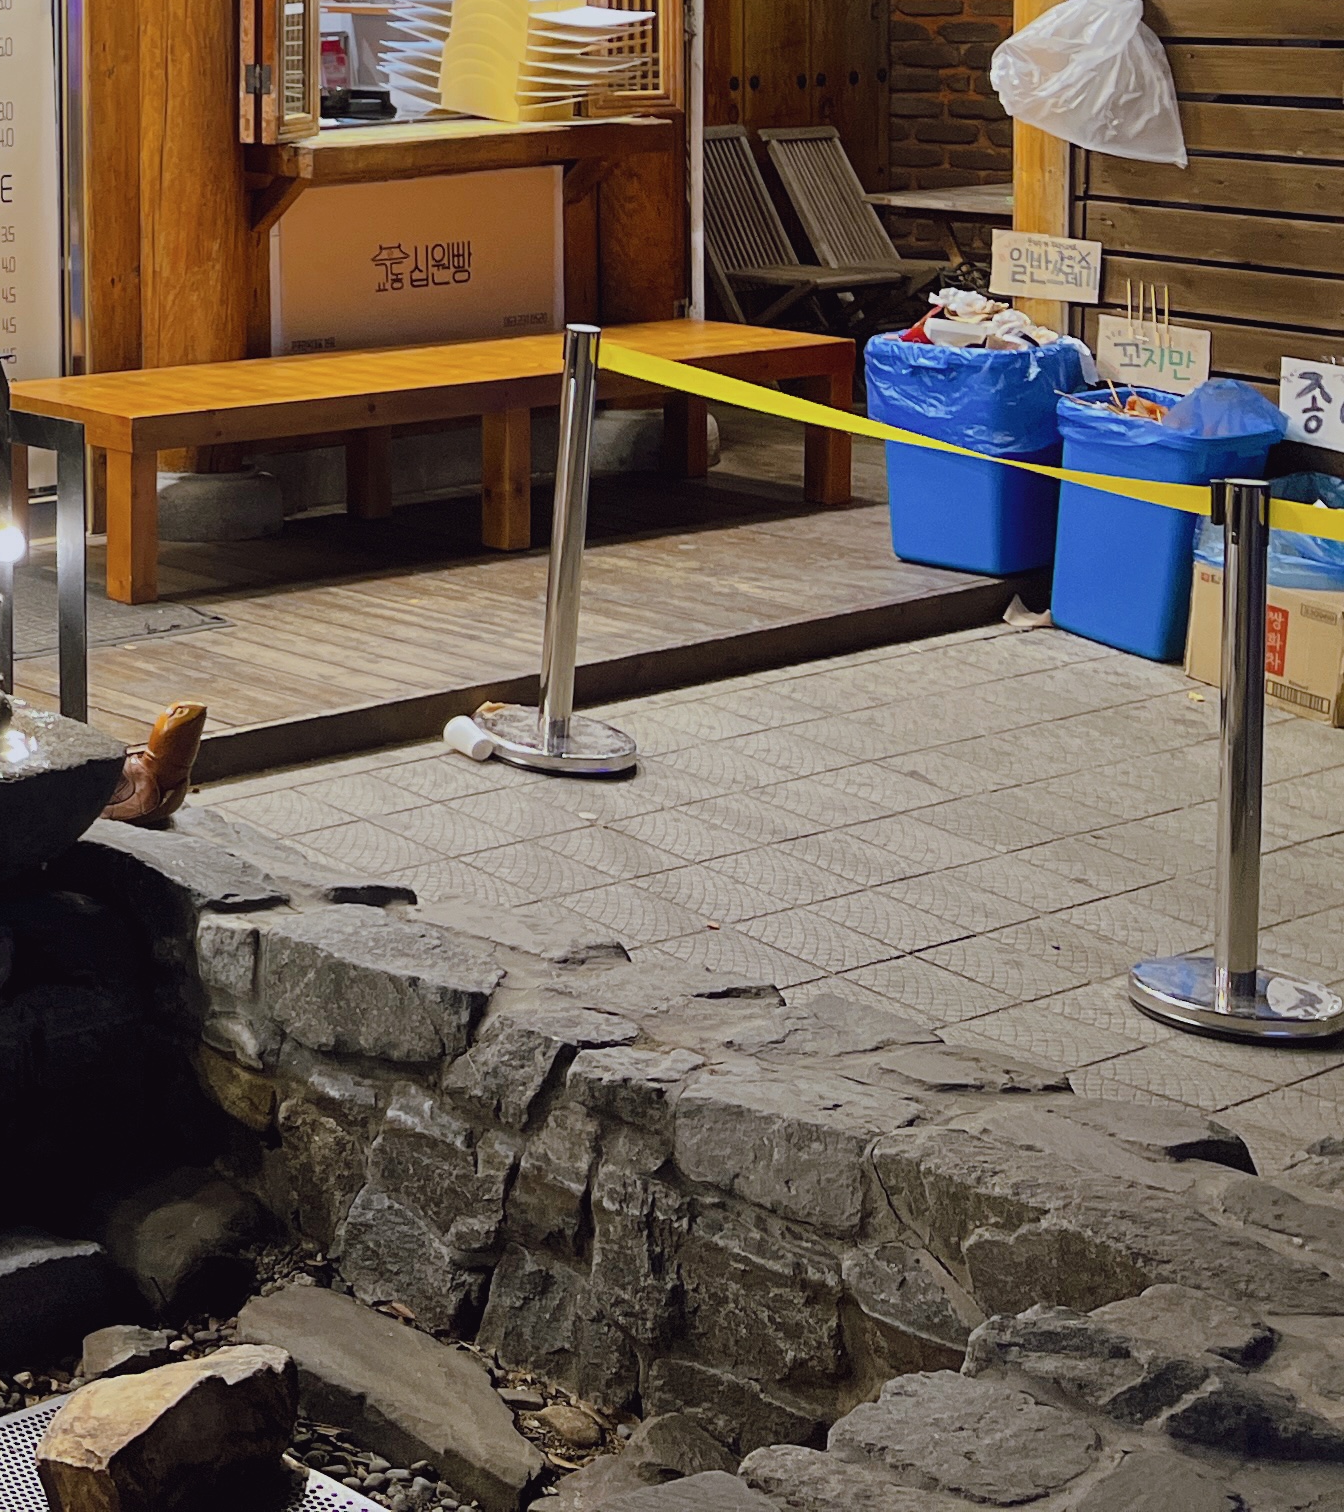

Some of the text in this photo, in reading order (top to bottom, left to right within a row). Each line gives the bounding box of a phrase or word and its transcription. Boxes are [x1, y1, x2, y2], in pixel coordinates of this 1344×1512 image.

[374, 241, 472, 293] 교동 십원빵
[1295, 371, 1344, 435] 종
